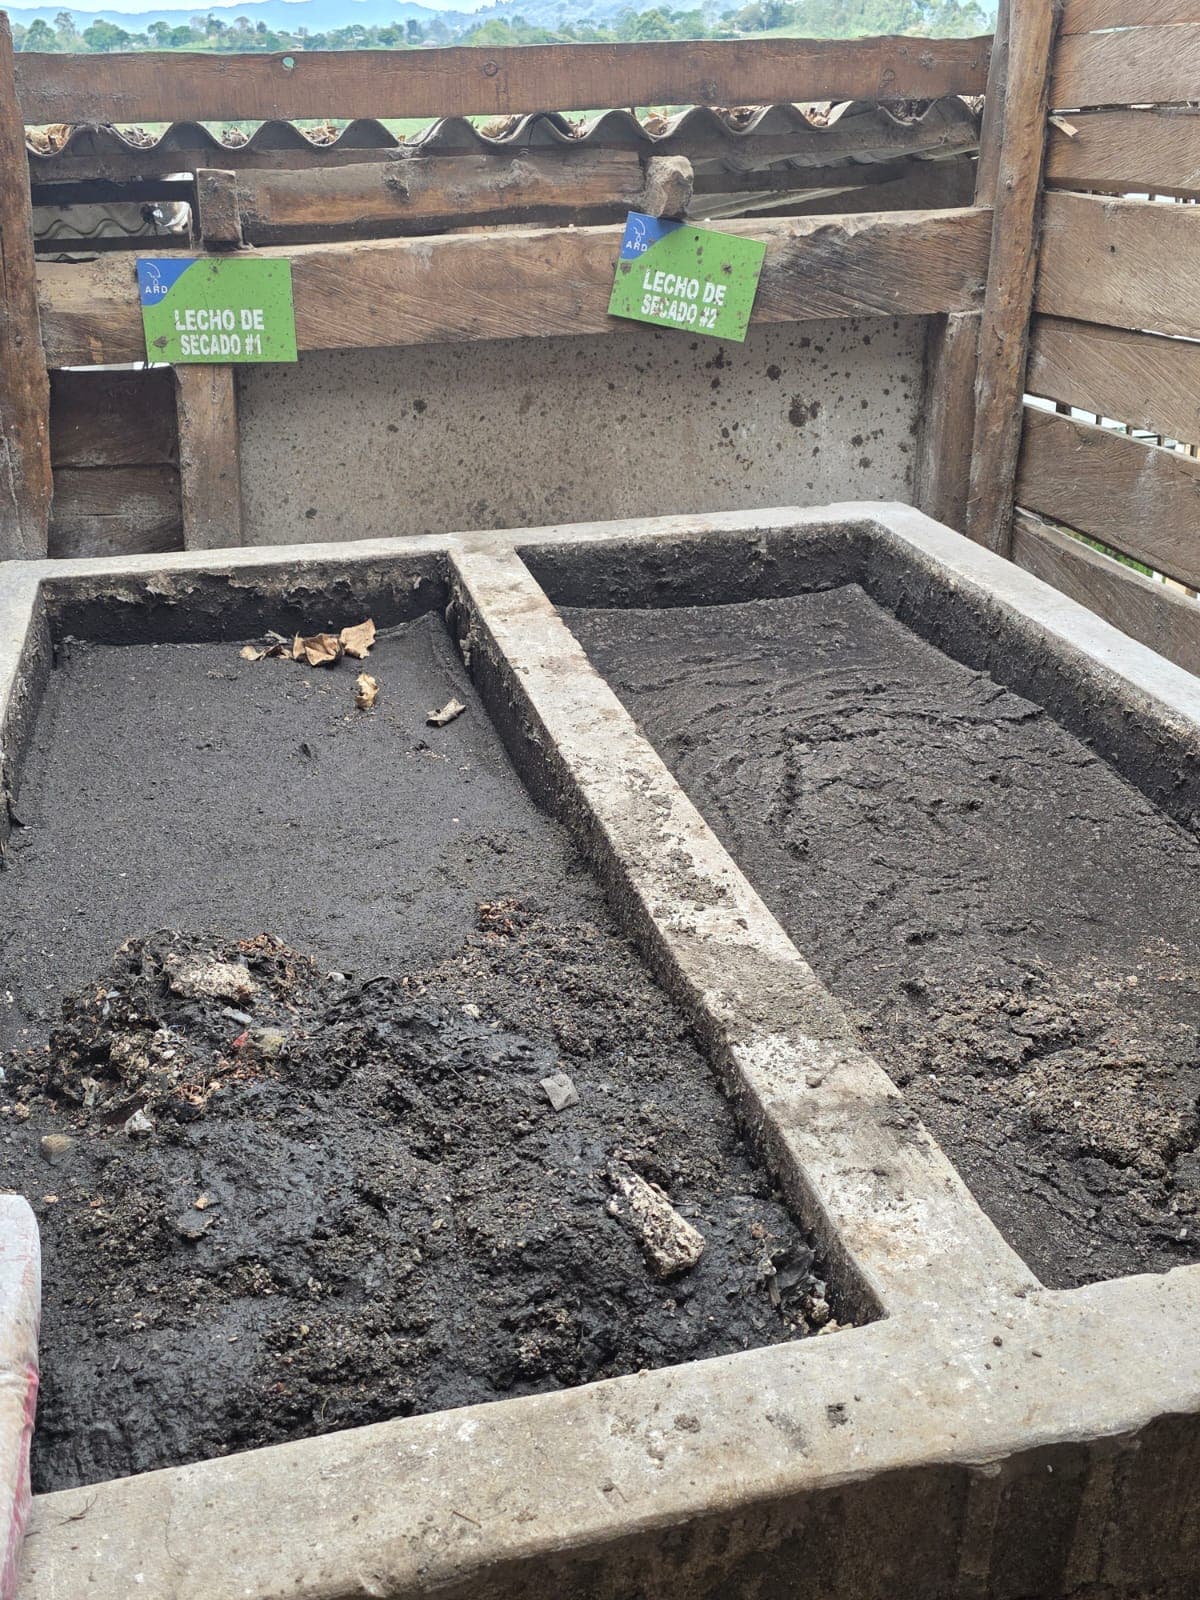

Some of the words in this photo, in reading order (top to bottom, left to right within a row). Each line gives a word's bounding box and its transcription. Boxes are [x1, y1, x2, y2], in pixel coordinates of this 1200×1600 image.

[625, 240, 648, 252] ARD
[145, 285, 168, 295] ARD
[642, 268, 700, 300] LECHO
[703, 281, 727, 306] DE
[174, 309, 236, 331] LECHO
[240, 309, 265, 331] DE
[641, 294, 698, 324] SECADO
[699, 306, 719, 329] #2
[180, 333, 241, 356] SECADO
[245, 333, 262, 355] #1
